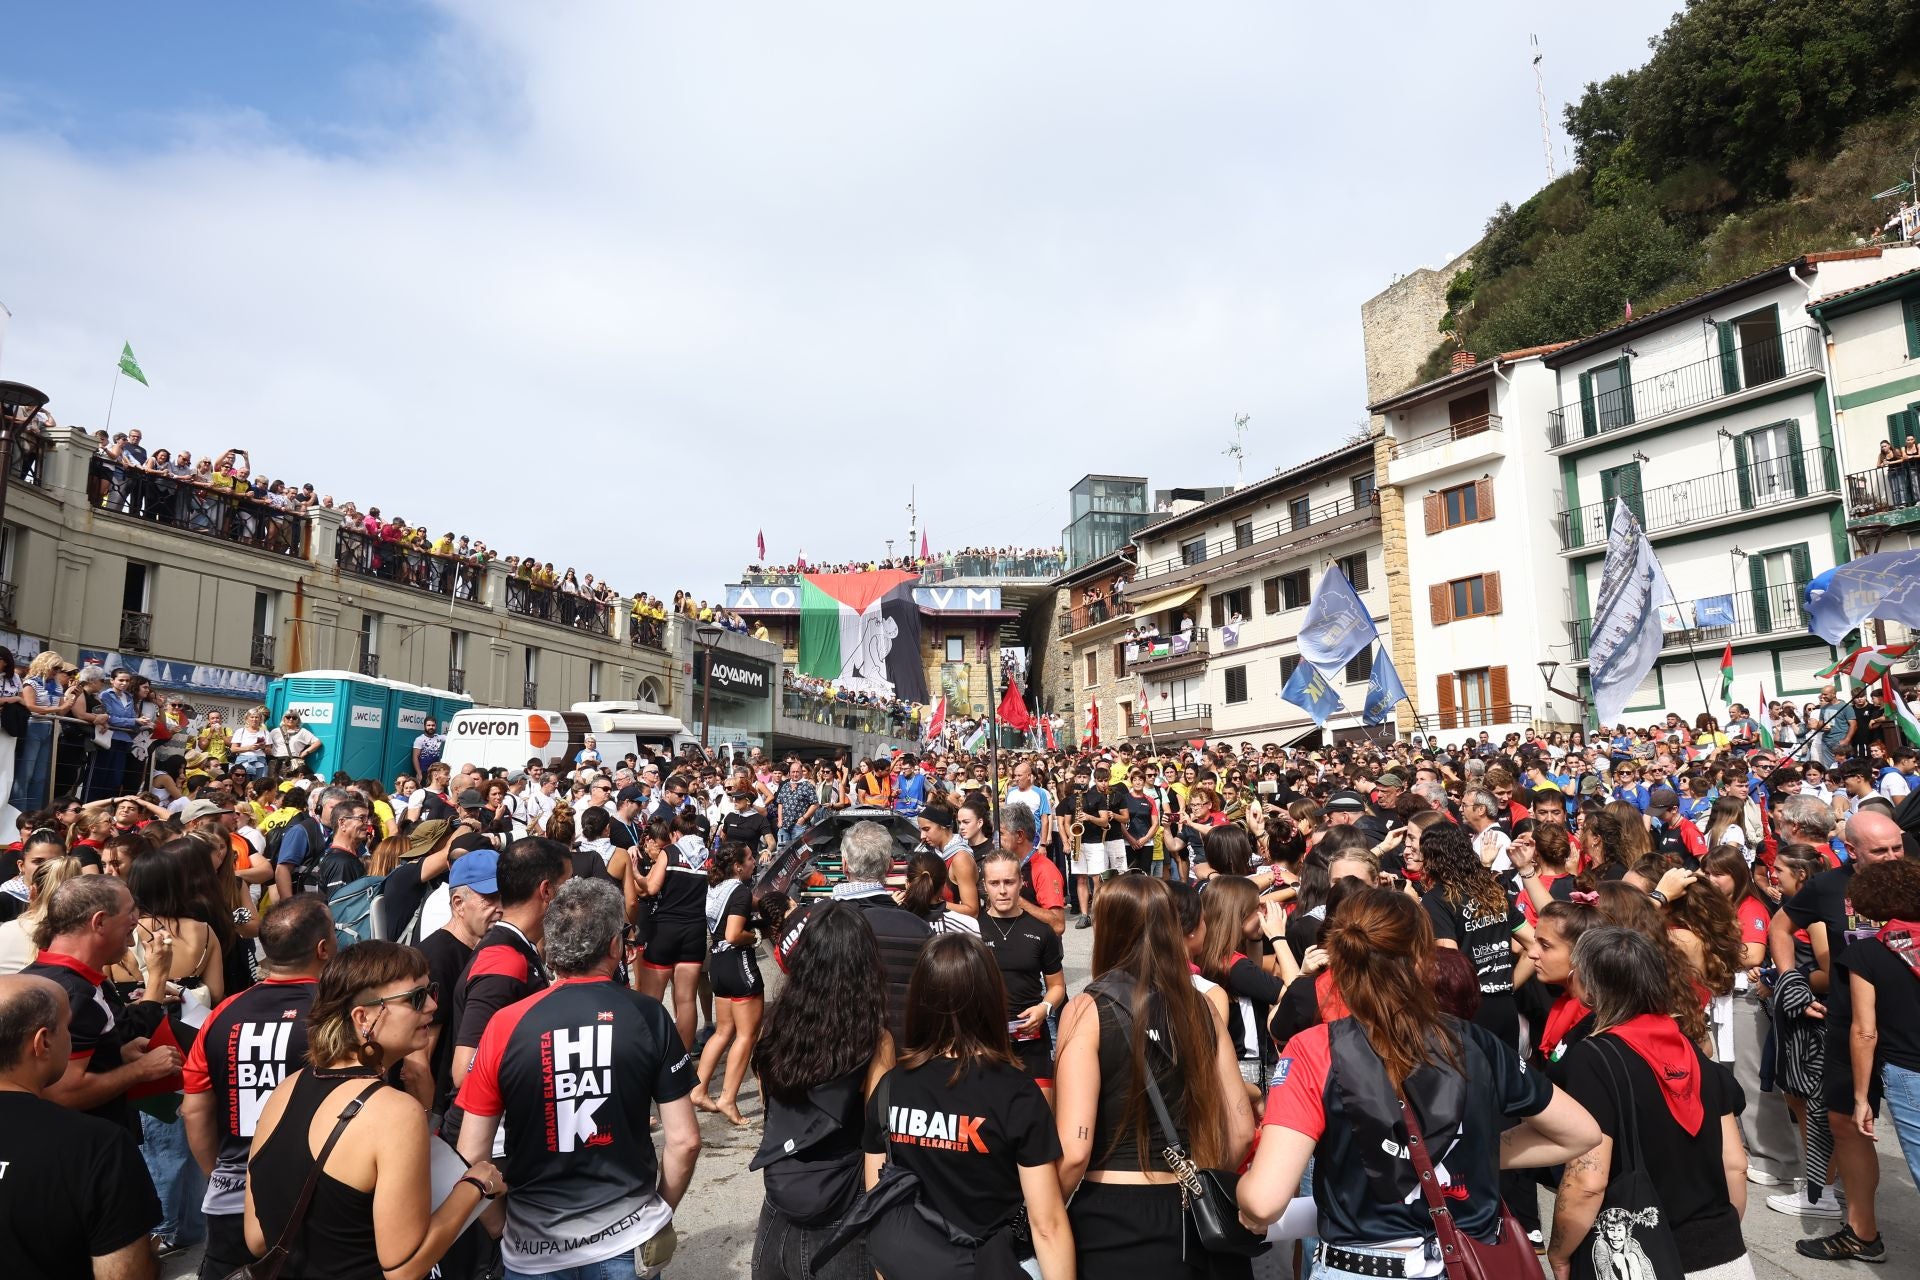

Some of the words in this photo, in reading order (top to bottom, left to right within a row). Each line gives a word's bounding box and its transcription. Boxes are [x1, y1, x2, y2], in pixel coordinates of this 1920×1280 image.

[457, 719, 519, 736] overon
[228, 1023, 241, 1086] ELKARTEA
[238, 1022, 293, 1061] HI
[540, 1031, 555, 1099] ELKARTEA
[553, 1024, 613, 1072] HI
[555, 1069, 612, 1099] BAI
[230, 1089, 239, 1136] ARRAUN
[544, 1100, 557, 1152] ARRAUN
[556, 1097, 609, 1152] K
[919, 1137, 970, 1152] ELKARTEA
[514, 1238, 561, 1255] #AUPA
